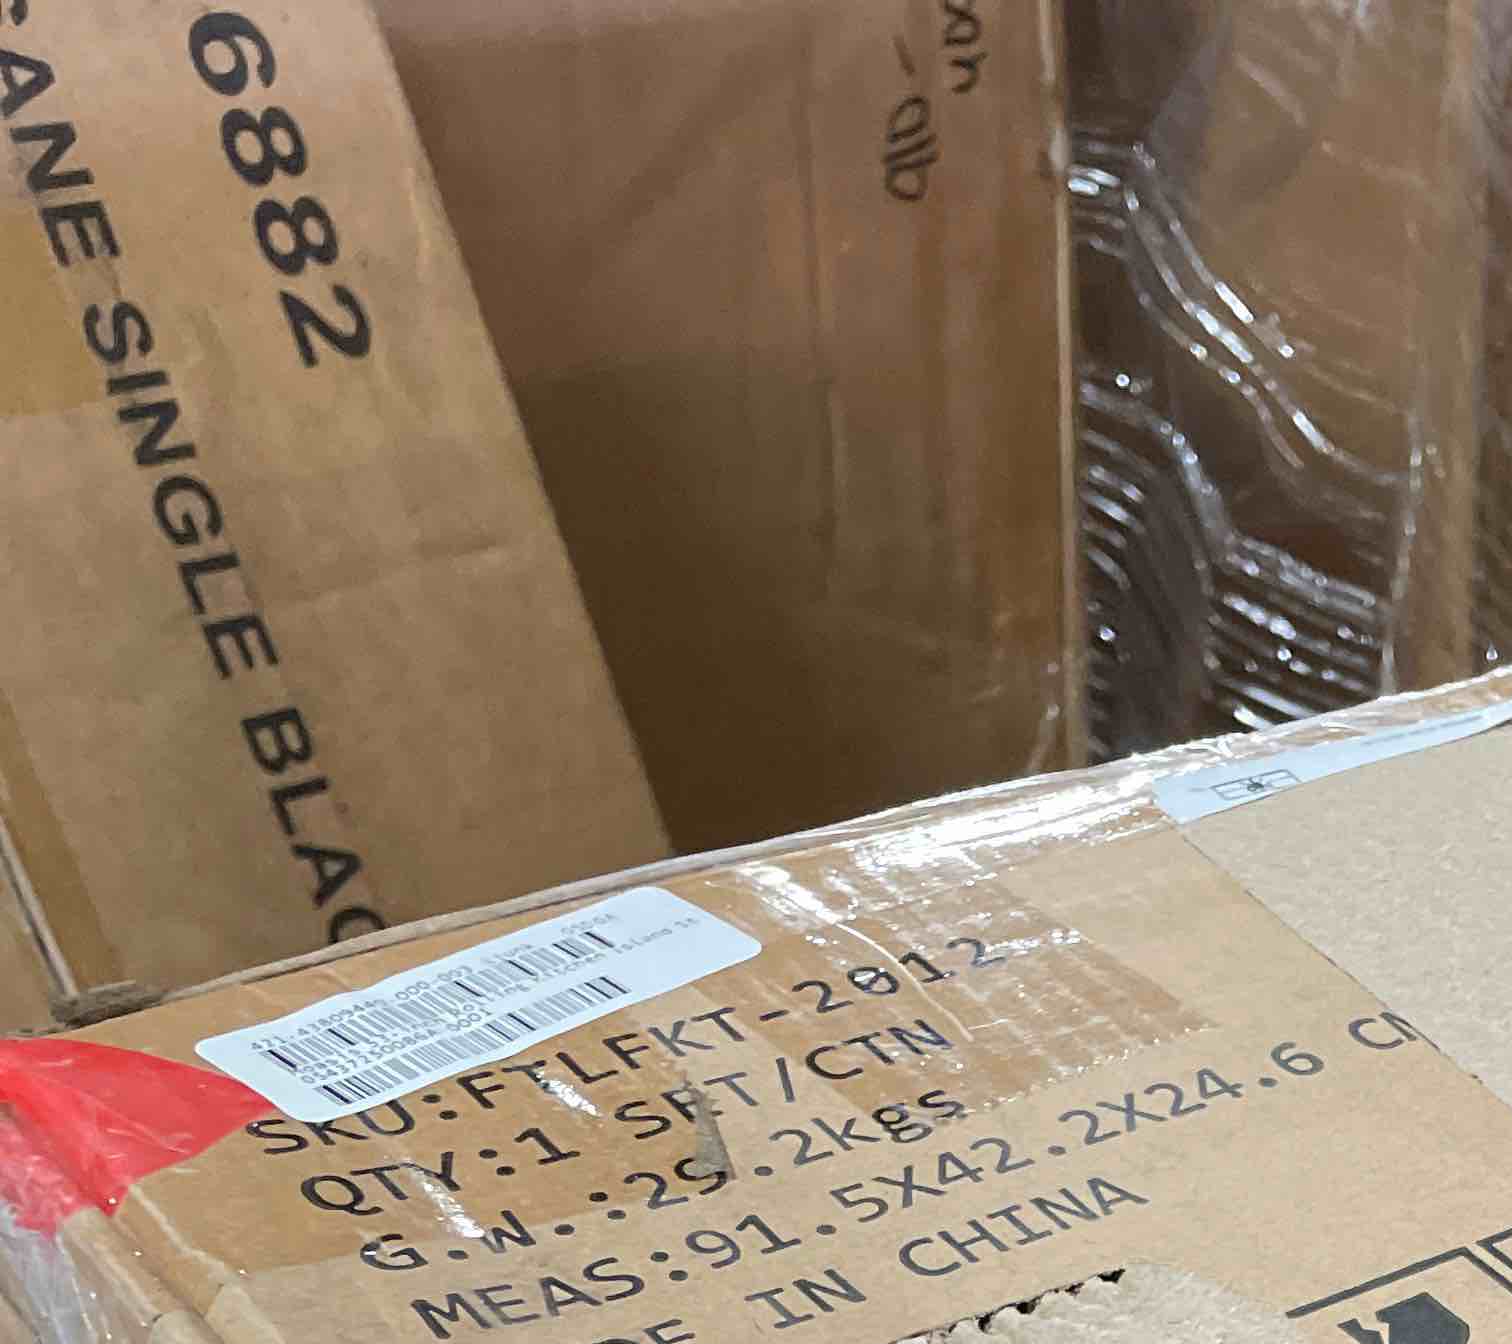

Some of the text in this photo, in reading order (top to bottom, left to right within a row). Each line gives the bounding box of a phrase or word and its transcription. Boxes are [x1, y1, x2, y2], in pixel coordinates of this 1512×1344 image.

[190, 11, 371, 368] 6882
[0, 0, 123, 268] ANE
[82, 301, 279, 680] SINGLE
[300, 1127, 581, 1218] QTY:1
[745, 1268, 867, 1330] IN
[898, 1177, 1150, 1278] CHINA
